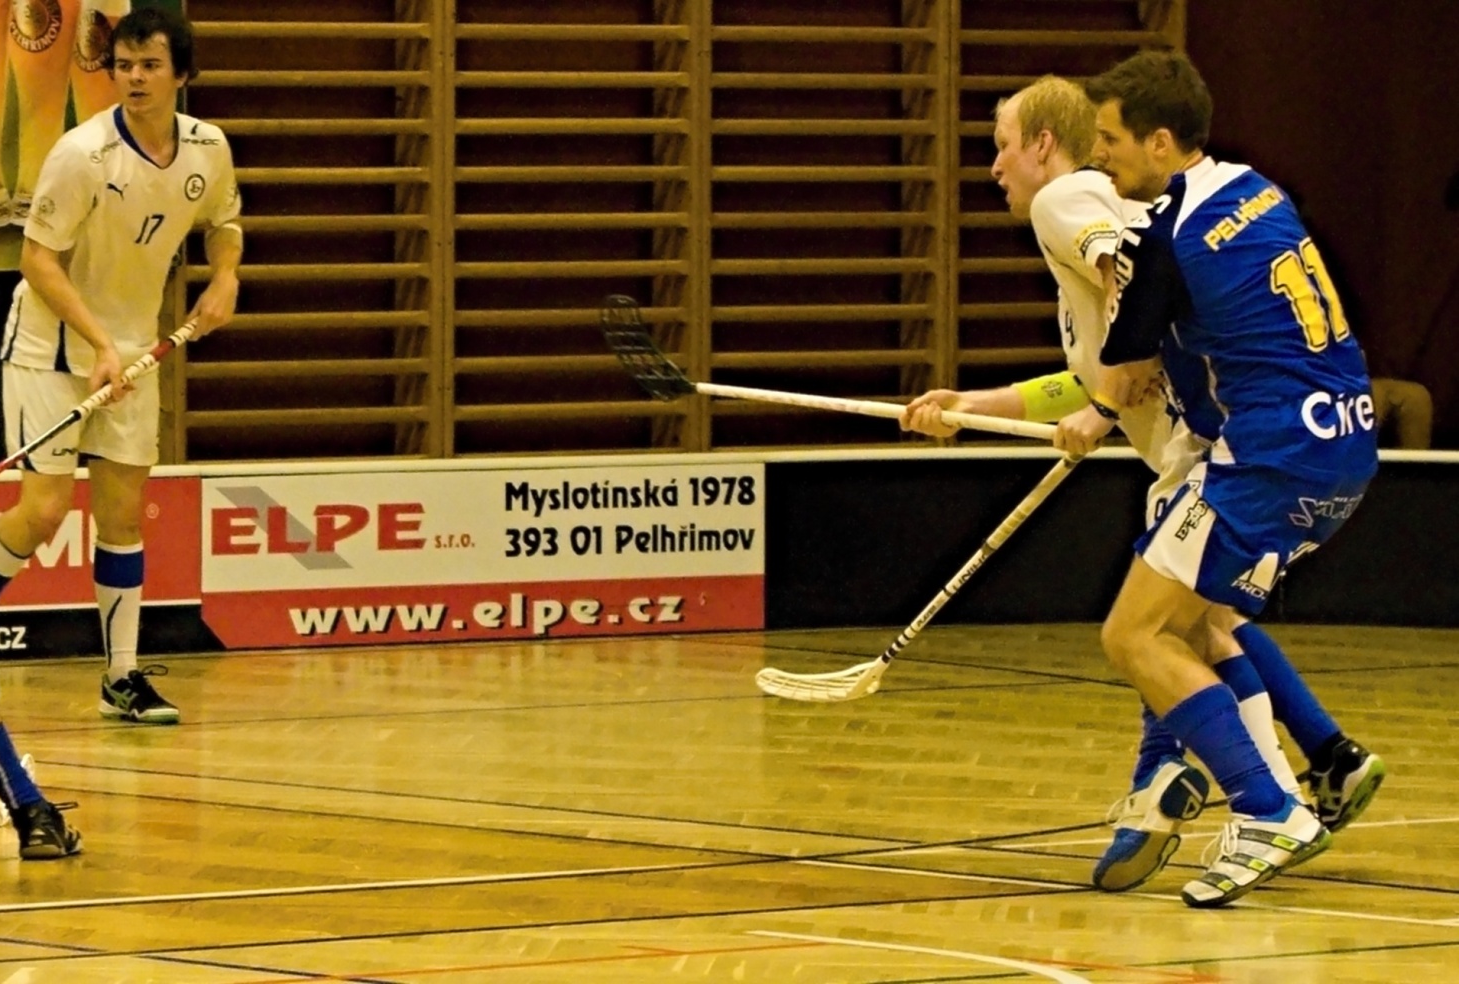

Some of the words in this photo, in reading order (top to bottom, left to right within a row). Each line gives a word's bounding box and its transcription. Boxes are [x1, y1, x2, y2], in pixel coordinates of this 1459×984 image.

[133, 213, 166, 246] 17
[1270, 236, 1350, 353] 11
[504, 478, 679, 518] Myslotínská
[689, 475, 756, 506] 1978
[210, 502, 427, 556] ELPE
[434, 533, 476, 549] s.r.o.
[505, 528, 559, 558] 393
[570, 526, 604, 556] 01
[615, 523, 756, 555] Pelhřimov
[288, 594, 685, 637] www.elpe.cz
